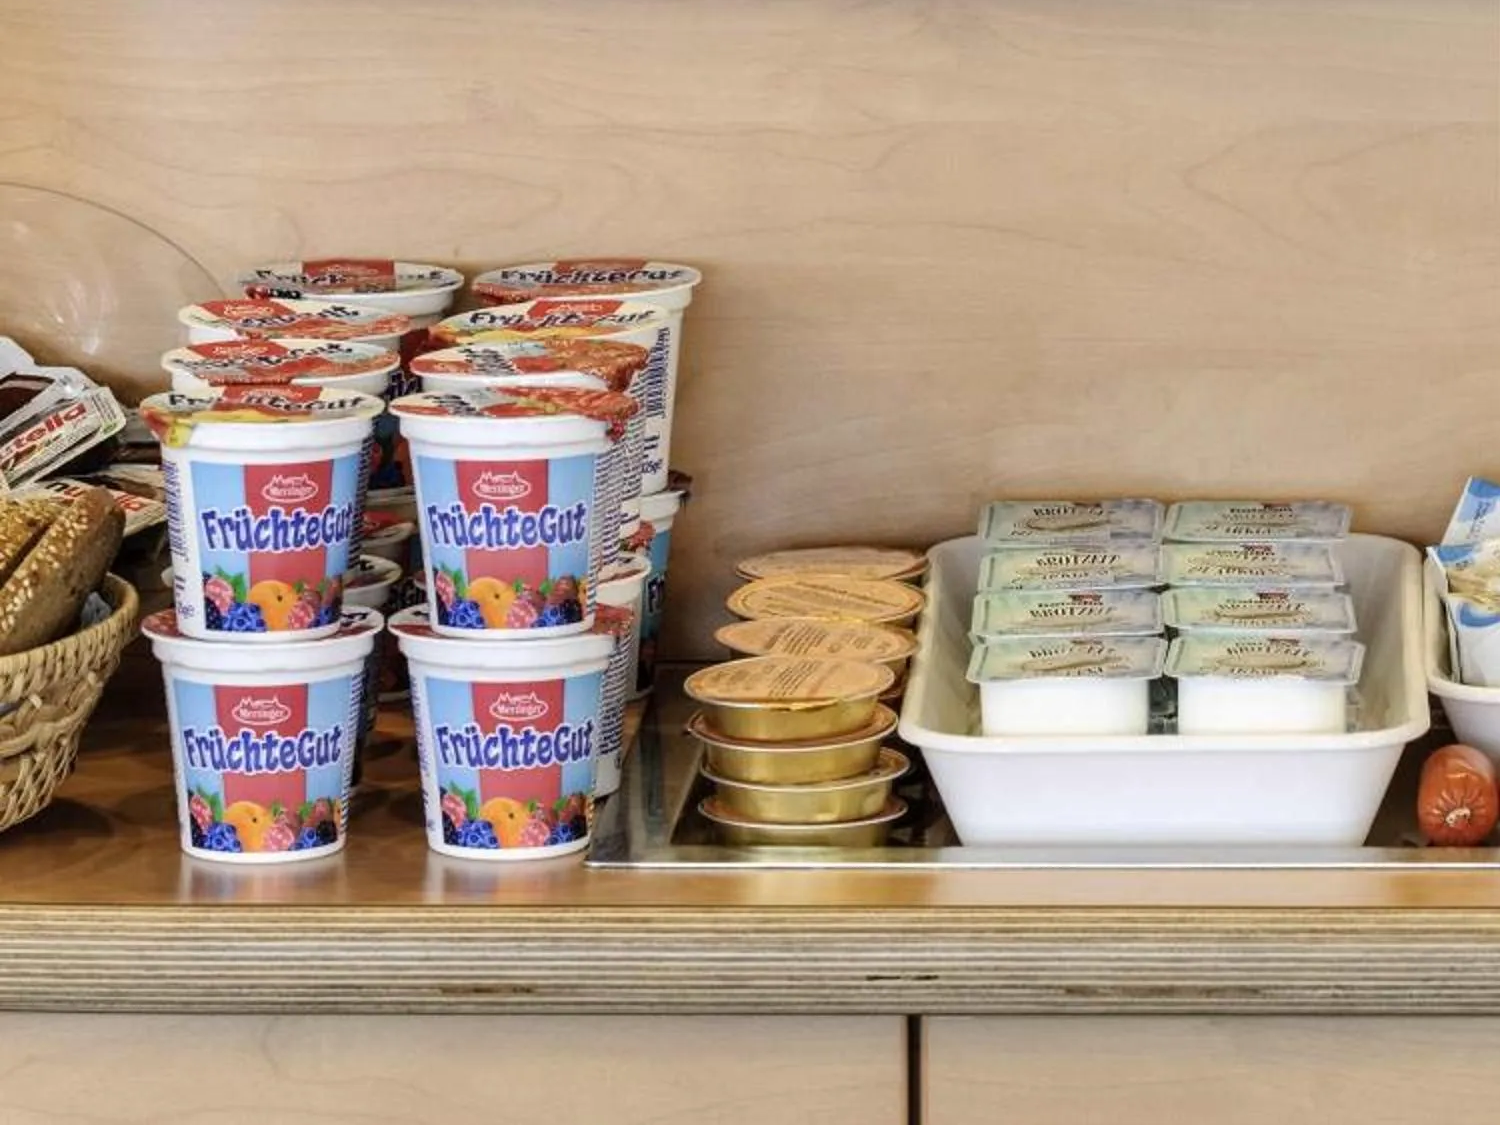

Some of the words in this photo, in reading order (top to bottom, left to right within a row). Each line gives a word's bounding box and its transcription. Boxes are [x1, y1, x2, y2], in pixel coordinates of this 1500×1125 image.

[201, 501, 354, 551] FrüchteGut
[427, 502, 587, 548] FrüchteGut
[183, 725, 343, 773] FrüchteGut
[436, 721, 596, 769] FrüchteGut
